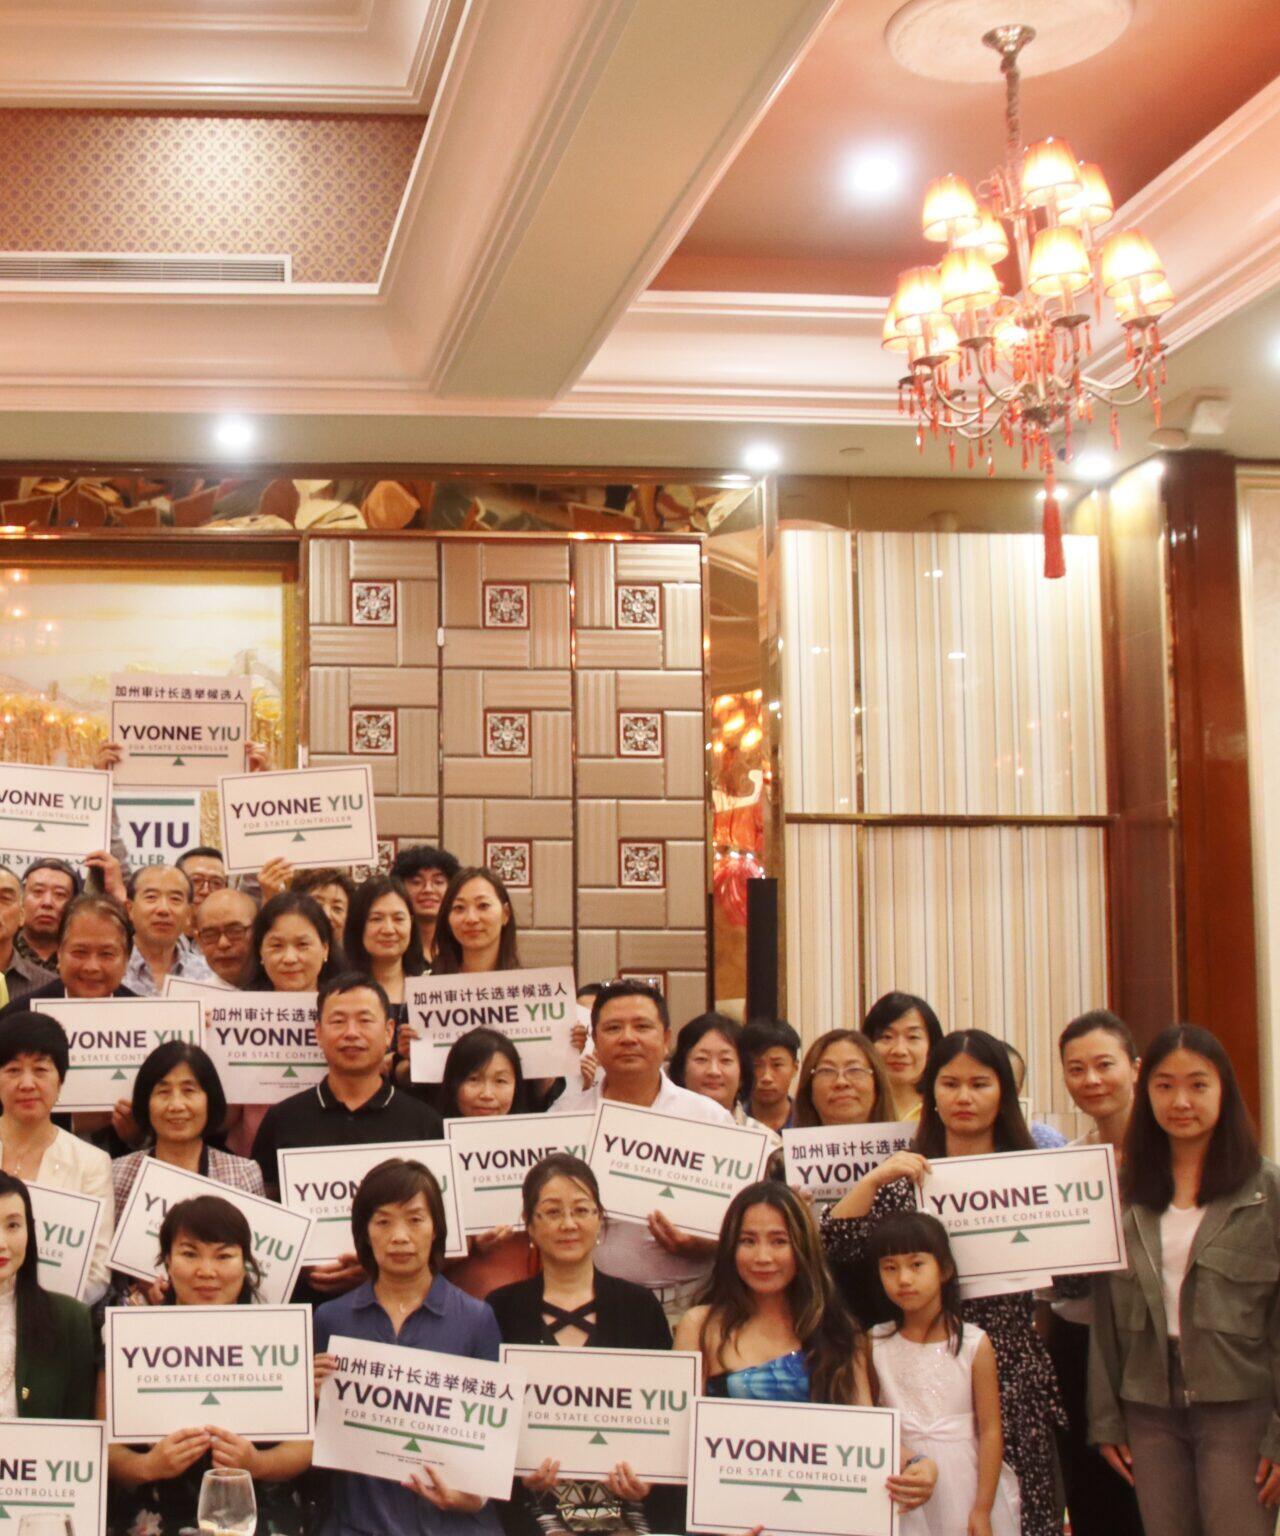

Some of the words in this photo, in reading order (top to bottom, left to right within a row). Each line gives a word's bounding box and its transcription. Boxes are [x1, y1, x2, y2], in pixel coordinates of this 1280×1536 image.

[119, 724, 204, 741] YVONNE
[209, 725, 241, 741] YIU
[71, 795, 103, 812] YIU
[230, 797, 323, 819] YVONNE
[328, 794, 363, 812] YIU
[129, 822, 189, 848] YIU
[413, 983, 568, 1006] 加州审计长选举候选人
[417, 1005, 521, 1028] YVONNE
[527, 1002, 566, 1022] YIU
[216, 1028, 318, 1047] YVONNE
[604, 1135, 706, 1172] YVONNE
[713, 1155, 754, 1180] YIU
[610, 1159, 633, 1171] FOR
[634, 1164, 665, 1178] STATE
[667, 1171, 734, 1191] CONTROLLER
[930, 1186, 1051, 1216] YVONNE
[1057, 1180, 1105, 1204] YIU
[947, 1219, 973, 1230] FOR
[975, 1215, 1011, 1227] STATE
[1014, 1208, 1090, 1223] CONTROLLER
[43, 1221, 85, 1249] YIU
[253, 1231, 294, 1261] YIU
[121, 1345, 245, 1368] YVONNE
[253, 1344, 300, 1366] YIU
[137, 1374, 162, 1384] FOR
[166, 1374, 202, 1384] STATE
[206, 1373, 283, 1383] CONTROLLER
[334, 1378, 452, 1420] YVONNE
[461, 1401, 508, 1428] YIU
[642, 1388, 687, 1411] YIU
[344, 1408, 366, 1418] FOR
[372, 1413, 406, 1426] STATE
[410, 1420, 486, 1440] CONTROLLER
[528, 1411, 554, 1421] FOR
[556, 1412, 592, 1423] STATE
[595, 1413, 671, 1426] CONTROLLER
[705, 1437, 829, 1466] YVONNE
[837, 1445, 886, 1469] YIU
[47, 1460, 93, 1483] YIU
[719, 1465, 745, 1476] FOR
[748, 1467, 785, 1479] STATE
[789, 1470, 868, 1484] CONTROLLER
